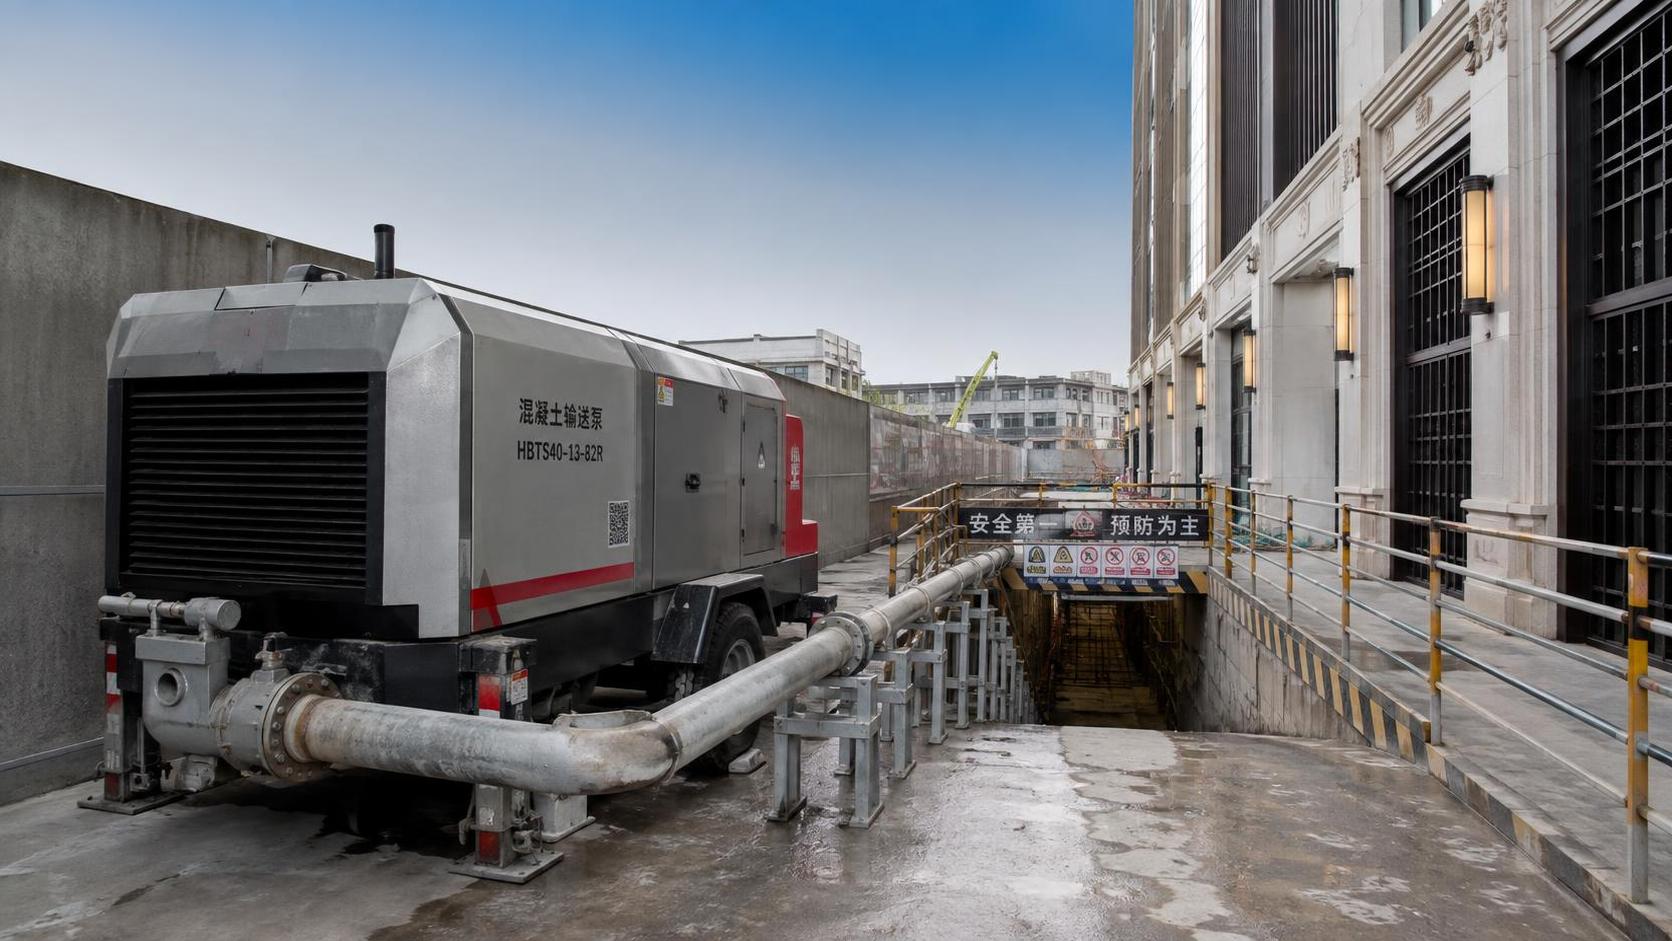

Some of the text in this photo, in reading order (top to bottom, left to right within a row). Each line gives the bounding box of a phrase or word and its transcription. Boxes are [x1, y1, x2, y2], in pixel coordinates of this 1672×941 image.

[519, 398, 602, 430] 混凝土输送泵
[517, 440, 603, 462] HBTS40-13-82R
[969, 513, 1199, 536] 安全第一 预防为主
